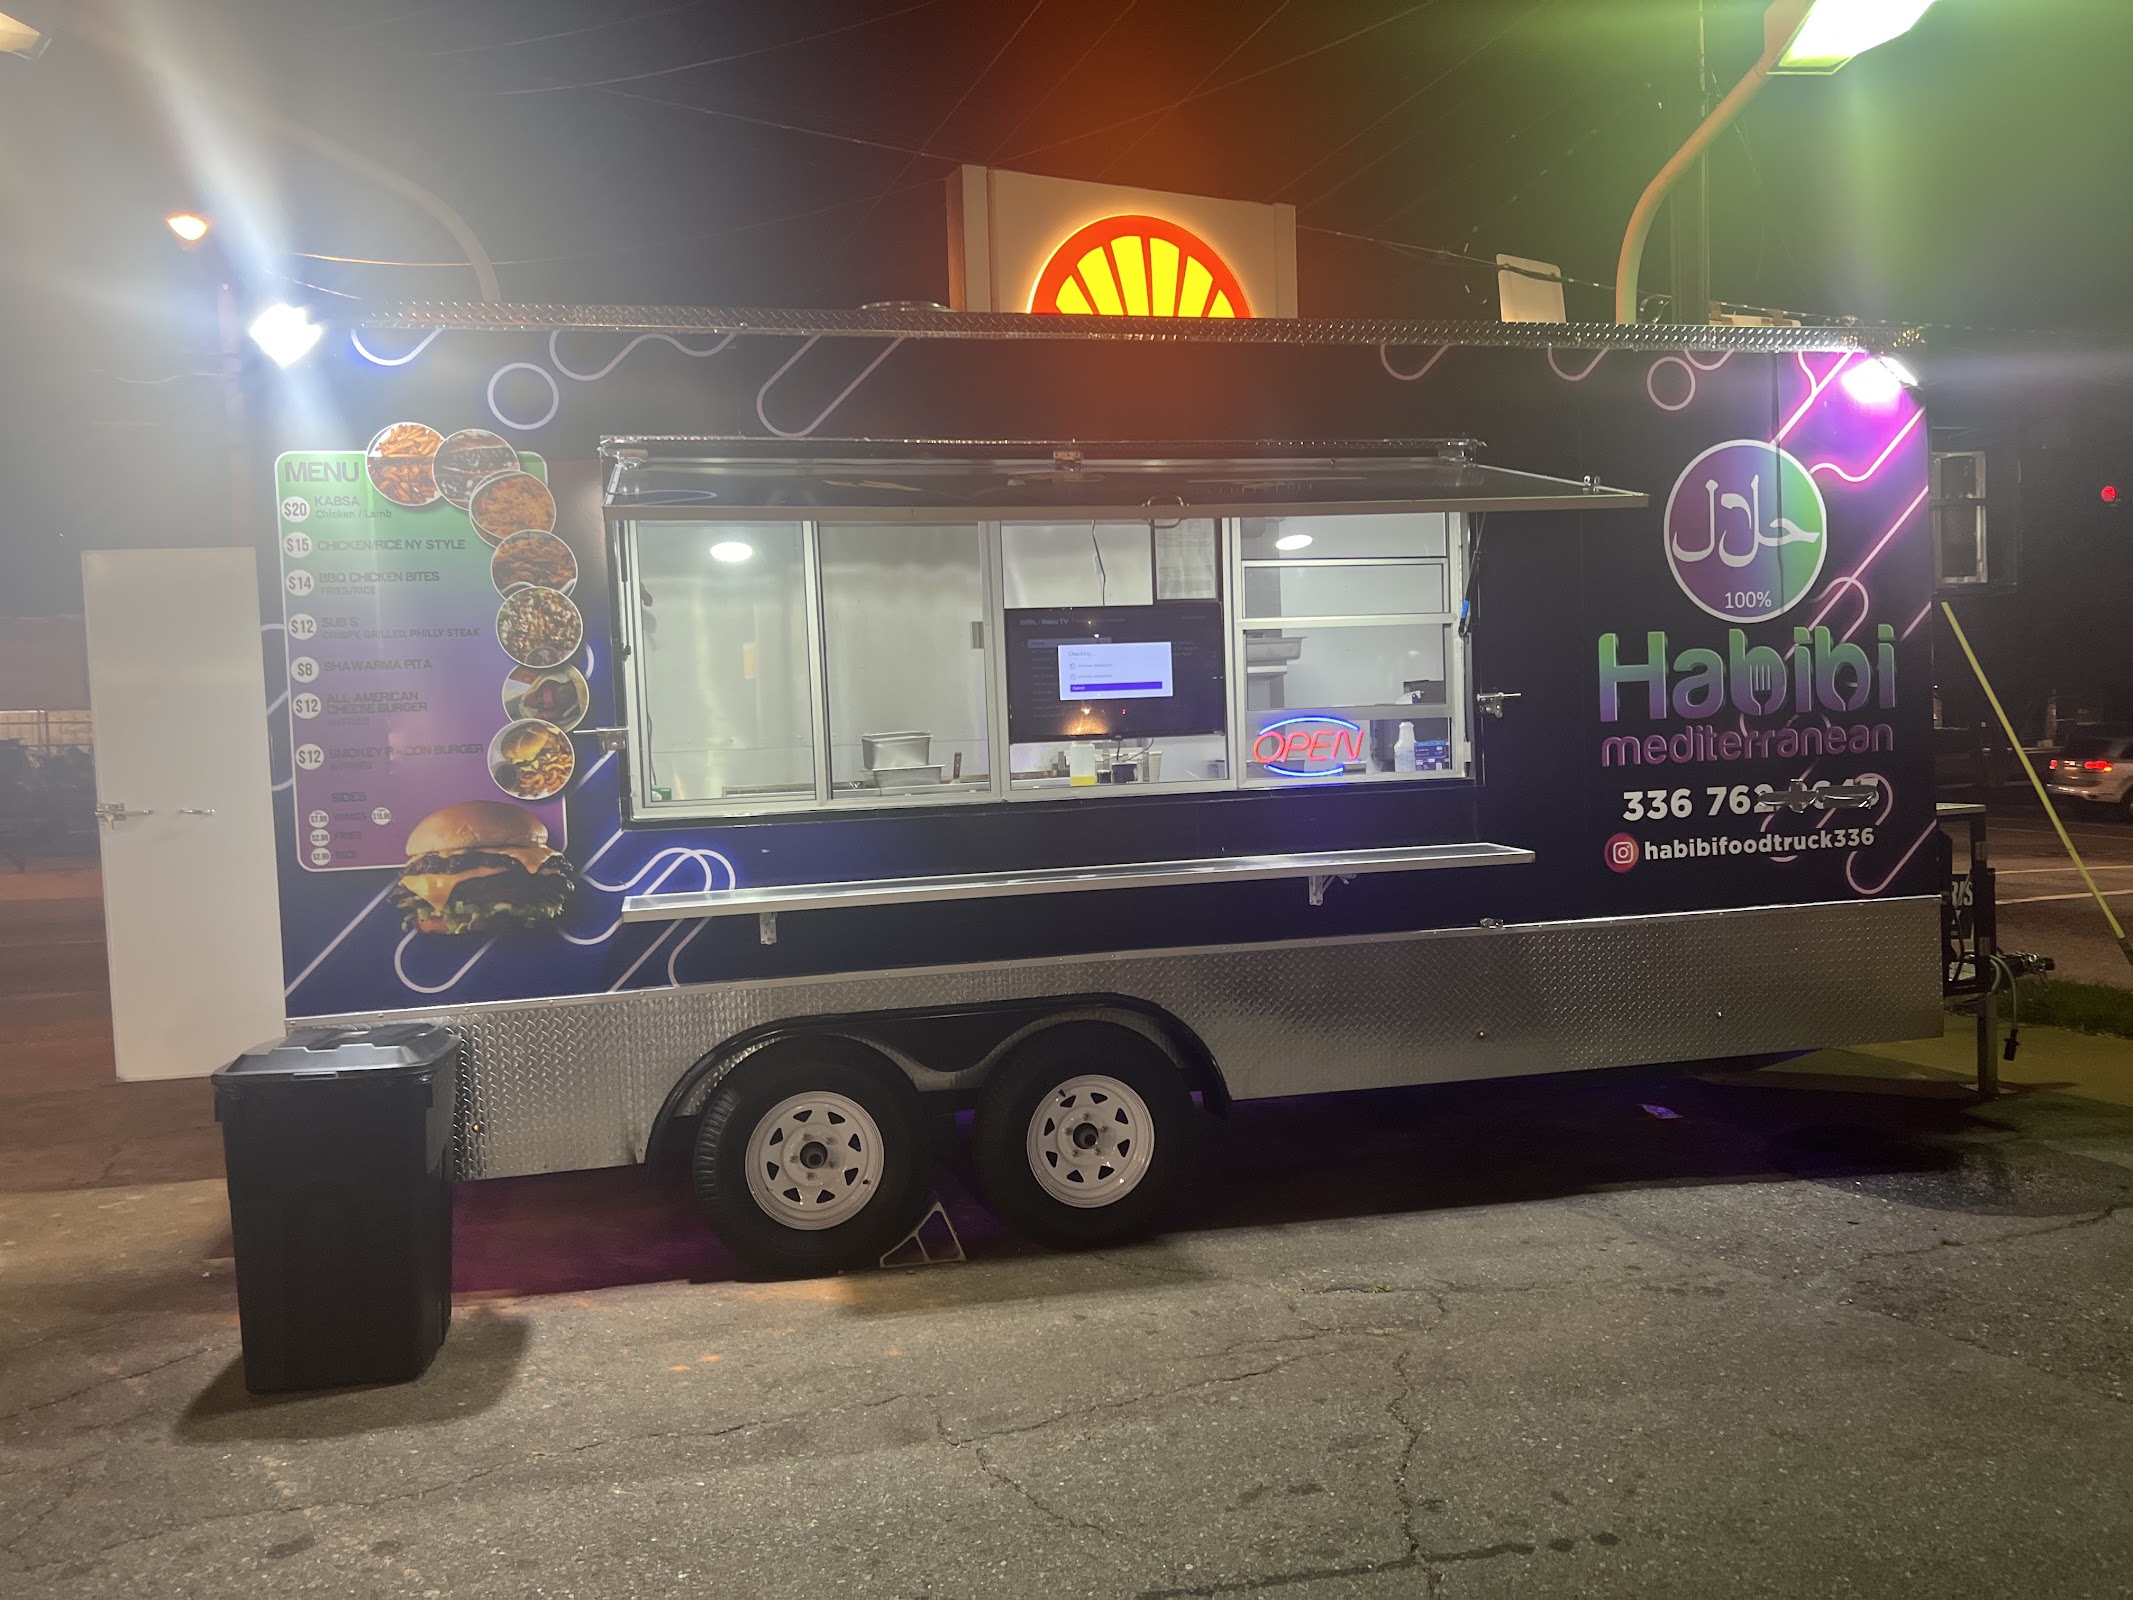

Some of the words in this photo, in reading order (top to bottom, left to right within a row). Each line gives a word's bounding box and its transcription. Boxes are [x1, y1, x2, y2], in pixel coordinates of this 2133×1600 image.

[285, 461, 360, 483] MENU
[284, 502, 308, 517] $20
[314, 496, 360, 507] KABSA
[315, 510, 355, 519] Chicken
[1671, 474, 1820, 568] حلال
[286, 538, 310, 553] $15
[405, 539, 421, 551] NY
[426, 539, 466, 550] STYLE
[288, 575, 312, 591] $14
[319, 573, 346, 584] BBQ
[349, 572, 403, 583] CHICKEN
[406, 571, 440, 582] BITES
[1724, 591, 1772, 609] 100%
[291, 619, 314, 635] $12
[410, 628, 444, 638] PHILLY
[447, 627, 480, 637] STEAK
[297, 662, 313, 676] $8
[404, 659, 433, 670] PITA
[1598, 624, 1896, 722] Habibi
[296, 698, 319, 714] $12
[378, 701, 428, 713] BURGER
[298, 749, 321, 764] $12
[434, 744, 484, 755] BURGER
[1253, 728, 1365, 765] OPEN
[1601, 723, 1895, 767] mediterranean
[1622, 789, 1693, 821] 336
[1644, 827, 1875, 860] habibifoodtruck336
